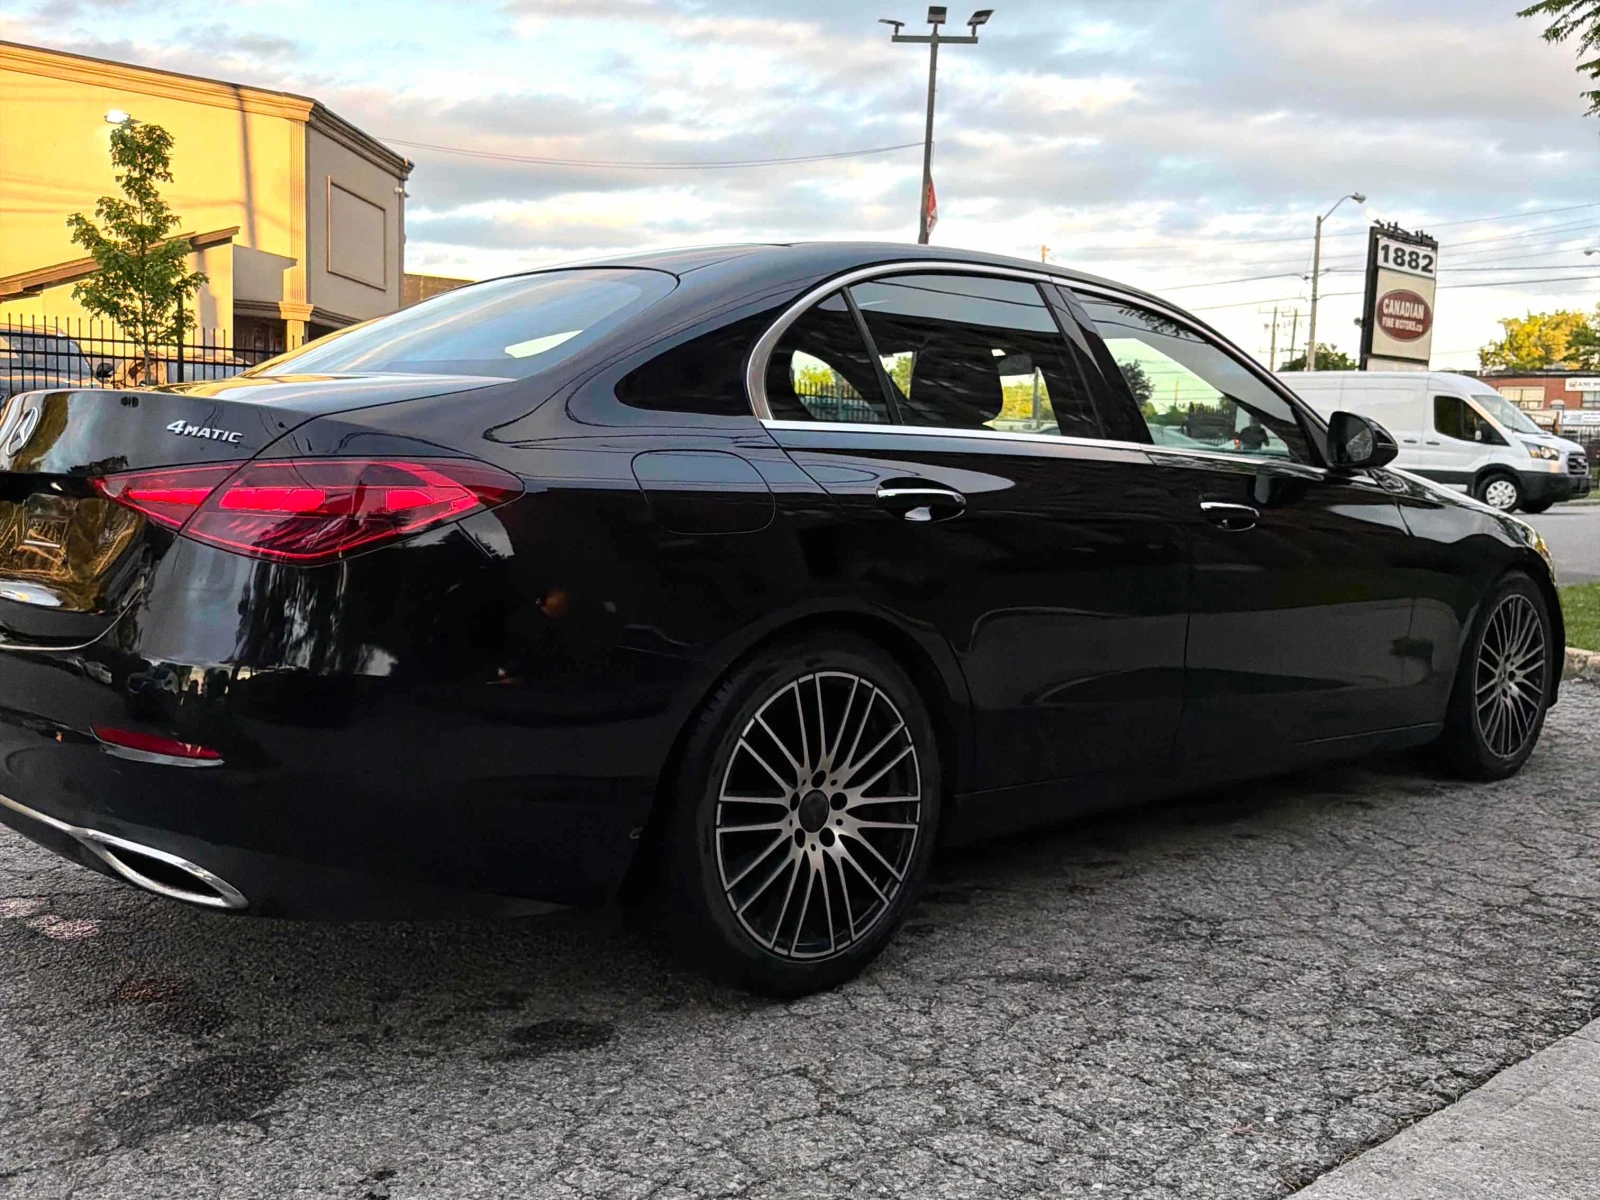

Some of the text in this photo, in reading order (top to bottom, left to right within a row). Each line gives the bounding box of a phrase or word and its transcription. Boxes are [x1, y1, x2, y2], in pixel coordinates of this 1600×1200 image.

[1380, 244, 1434, 273] 1882
[1382, 298, 1424, 319] CANADIAN
[166, 419, 243, 443] 4MATIC
